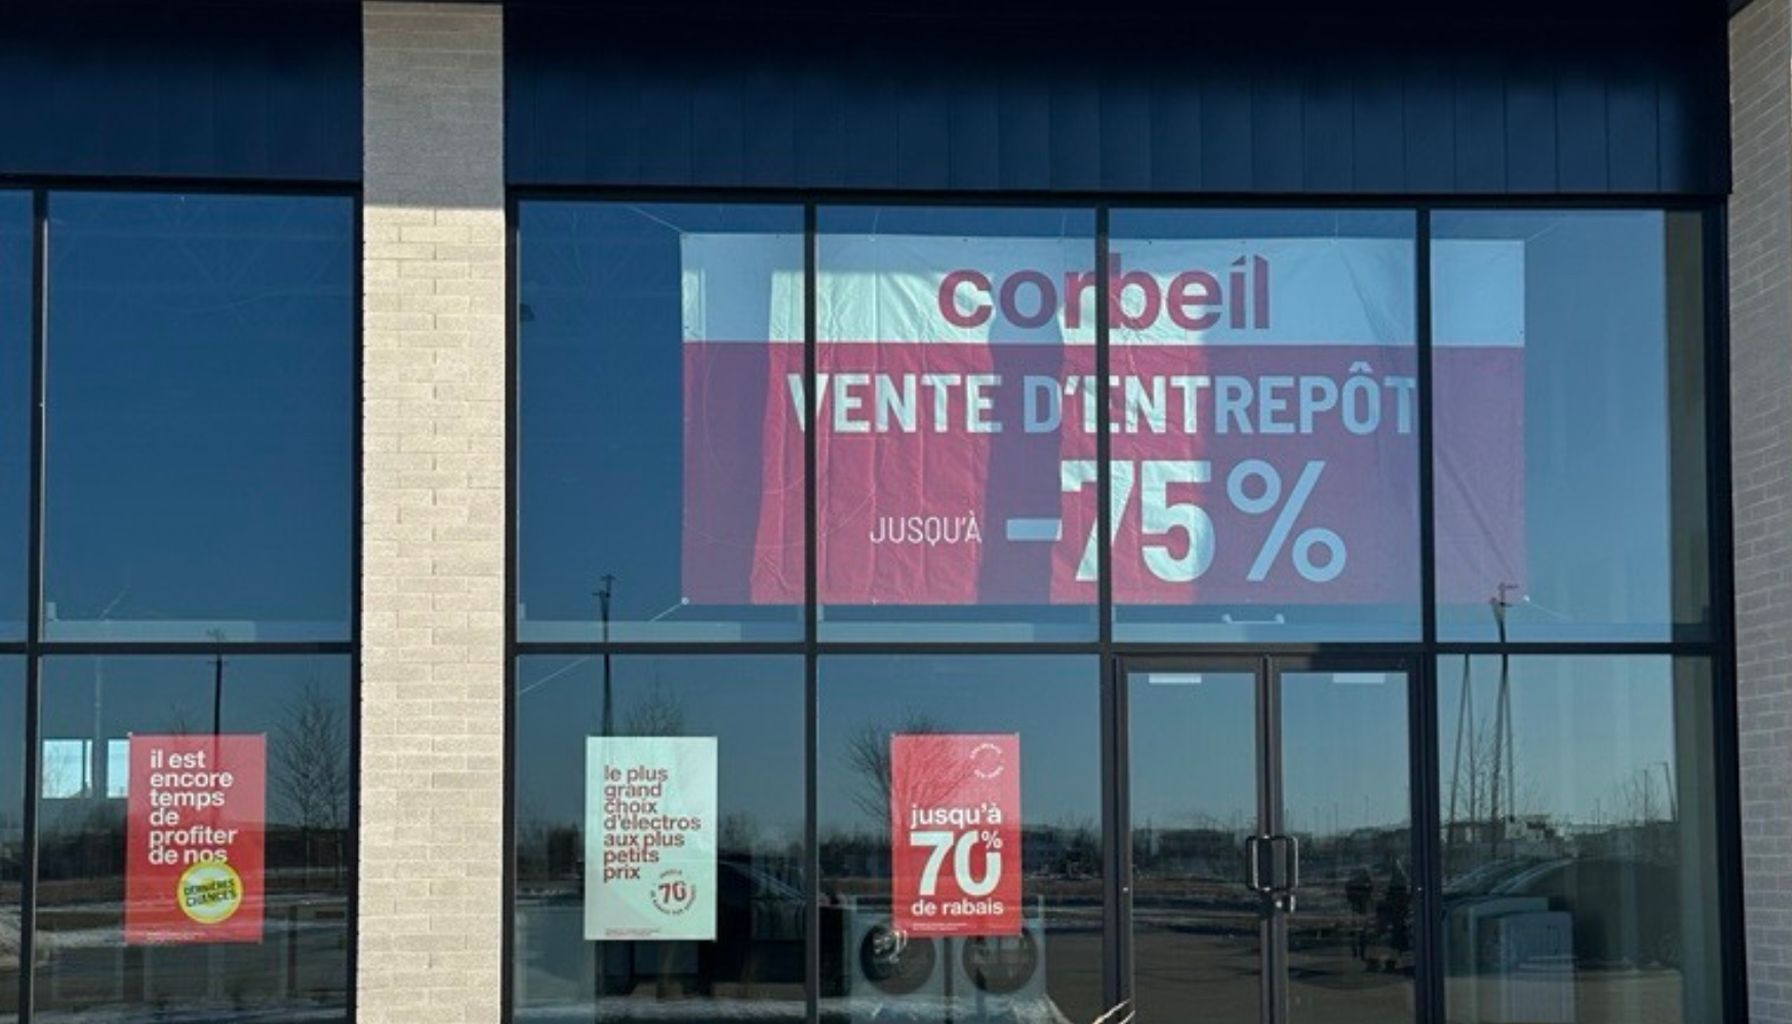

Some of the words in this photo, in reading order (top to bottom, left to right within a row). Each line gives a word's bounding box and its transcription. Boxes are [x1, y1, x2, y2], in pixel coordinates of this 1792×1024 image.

[938, 252, 1269, 331] corbeil
[787, 373, 1003, 433] VENTE
[1023, 361, 1417, 435] D'ENTREPÔT
[869, 510, 982, 546] JUSQU'À
[150, 749, 163, 769] il
[169, 750, 206, 769] est
[150, 772, 234, 788] encore
[603, 765, 622, 782] le
[627, 765, 669, 785] plus
[149, 789, 226, 811] temps
[603, 782, 662, 801] grand
[603, 798, 658, 815] choix
[910, 803, 1002, 830] jusqu'à
[149, 807, 180, 827] de
[149, 826, 239, 849] profiter
[603, 833, 639, 847] aux
[643, 831, 686, 850] plus
[148, 845, 179, 866] de
[183, 848, 229, 864] nos
[603, 847, 660, 866] petits
[603, 864, 641, 884] prix
[911, 899, 937, 917] de
[942, 899, 1005, 916] rabais
